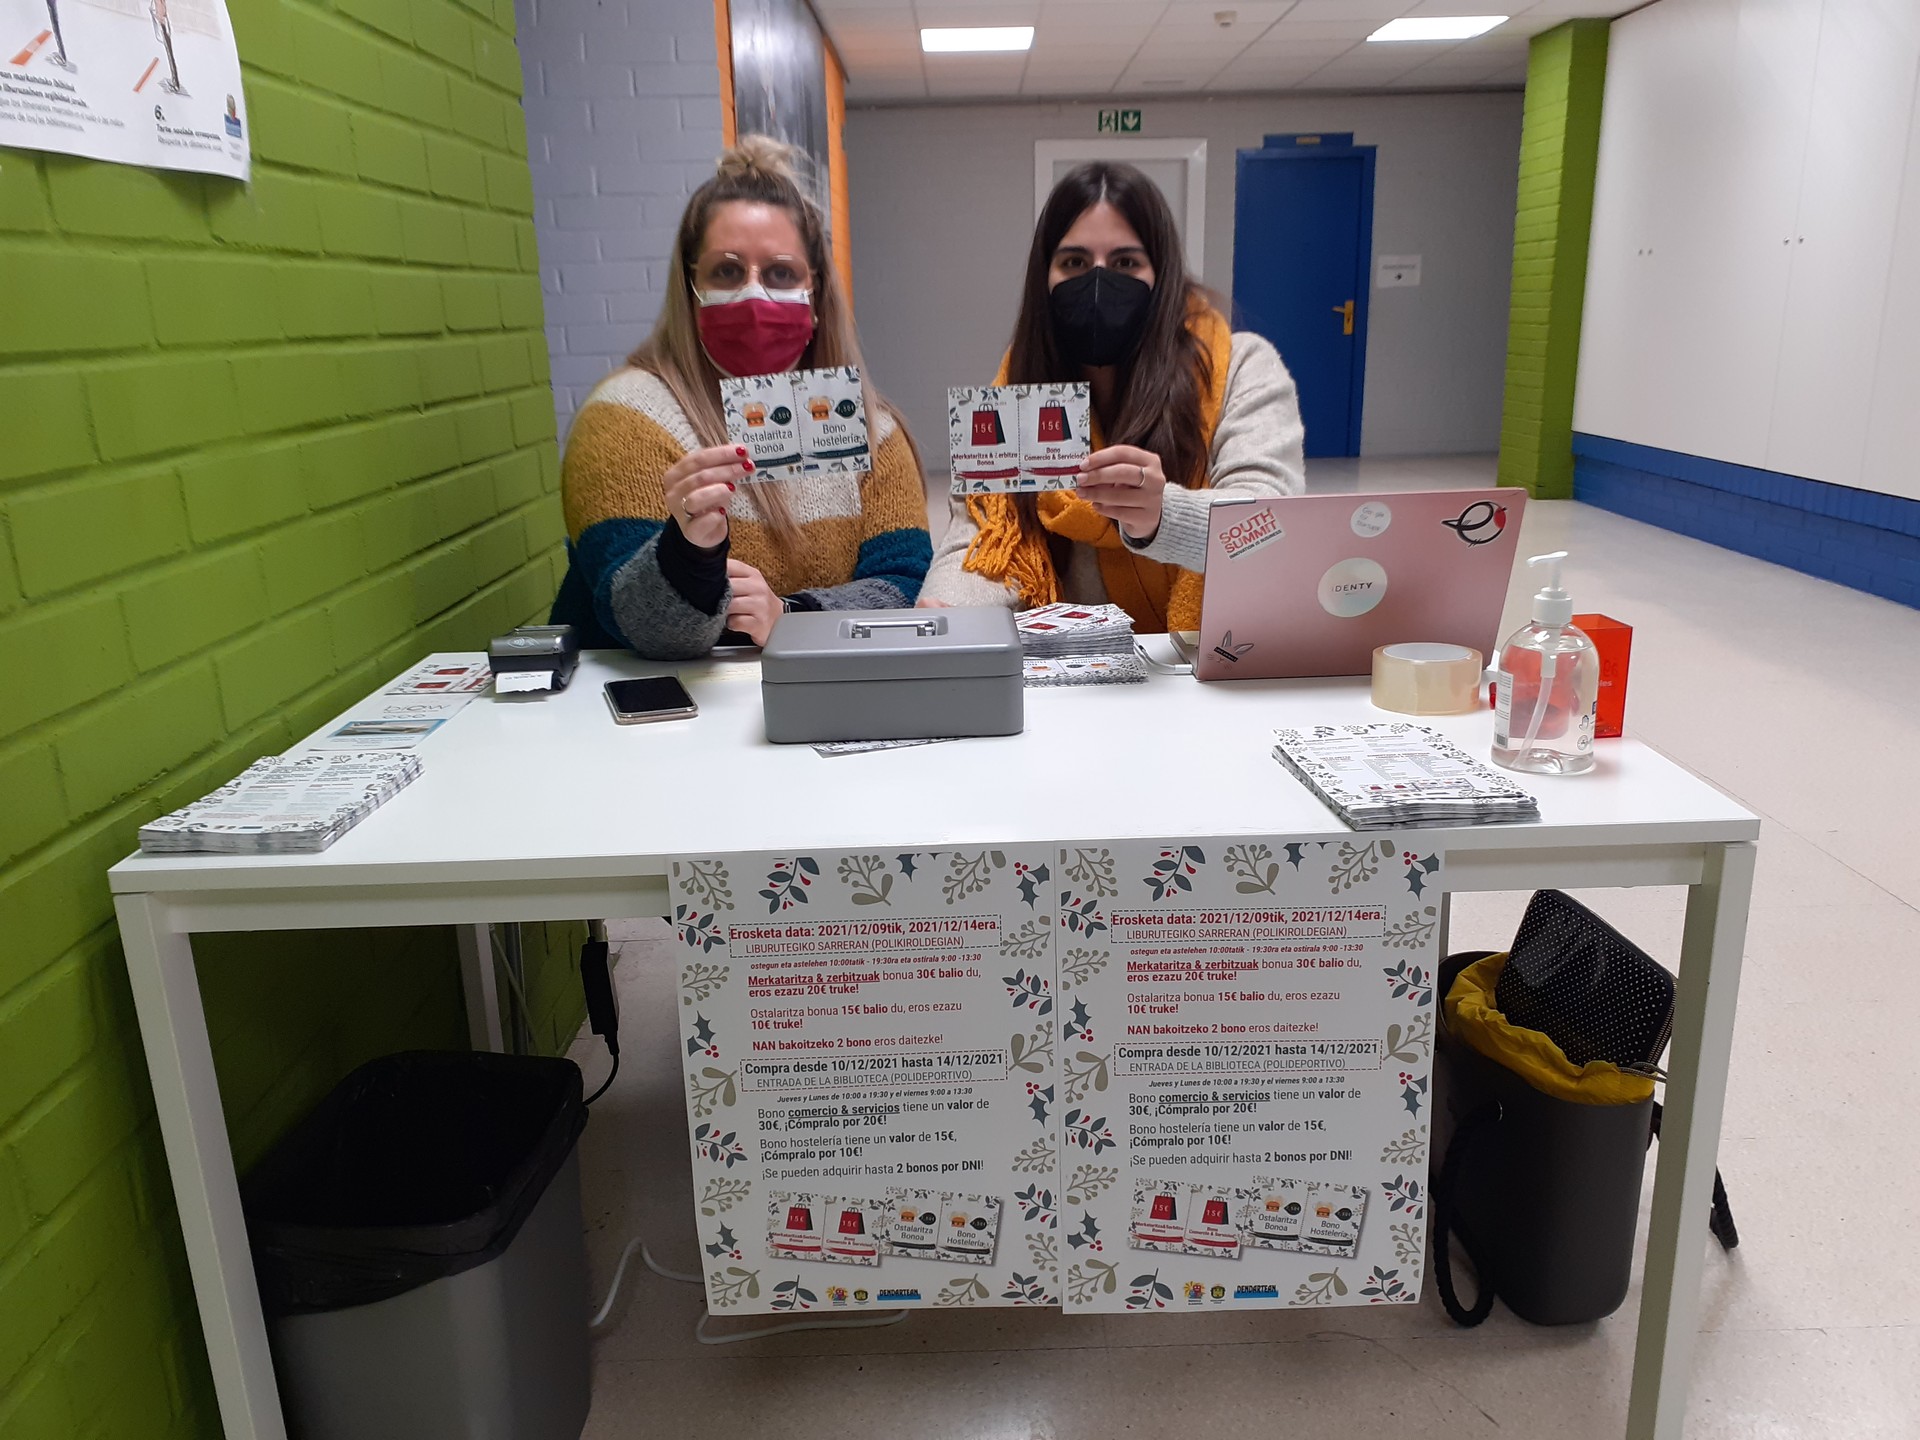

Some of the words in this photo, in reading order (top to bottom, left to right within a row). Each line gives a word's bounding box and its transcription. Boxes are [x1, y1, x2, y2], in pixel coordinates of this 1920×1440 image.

[155, 105, 166, 120] 6.
[823, 424, 846, 434] Bono
[974, 423, 992, 433] 15€
[1042, 420, 1060, 431] 15€
[742, 430, 793, 444] Ostalaritza
[813, 434, 860, 448] Hostelería
[754, 444, 784, 454] Bonoa
[1219, 508, 1274, 544] SOUTH
[1225, 520, 1276, 553] SUMMIT
[1229, 544, 1255, 559] INNOVATION
[1260, 530, 1282, 542] BUSINESS
[1112, 913, 1163, 926] Erosketa
[1166, 912, 1196, 924] data:
[1199, 911, 1287, 925] 2021/12/09tik,
[1291, 909, 1384, 924] 2021/12/14era.
[730, 926, 782, 941] Erosketa
[784, 925, 814, 937] data:
[817, 921, 905, 938] 2021/12/09tik,
[908, 918, 1000, 935] 2021/12/14era.
[1126, 928, 1195, 941] LIBURUTEGIKO
[1197, 928, 1249, 940] SARRERAN
[1252, 925, 1346, 938] (POLIKIROLDEGIAN)
[745, 941, 815, 954] LIBURUTEGIKO
[817, 939, 868, 953] SARRERAN
[871, 935, 964, 949] (POLIKIROLDEGIAN)
[1127, 960, 1191, 972] Merkataritza
[1194, 959, 1201, 972] &
[1204, 958, 1258, 972] zerbitzuak
[1261, 958, 1293, 968] bonua
[1296, 958, 1315, 968] 30€
[1318, 957, 1344, 967] balio
[1346, 956, 1361, 968] du,
[747, 974, 813, 985] Merkataritza
[816, 973, 823, 984] &
[826, 970, 879, 984] zerbitzuak
[882, 969, 913, 980] bonua
[916, 968, 935, 979] 30€
[938, 967, 963, 978] balio
[965, 966, 980, 978] du,
[1127, 973, 1149, 982] eros
[1151, 972, 1181, 981] ezazu
[1184, 971, 1204, 980] 20€
[1206, 970, 1236, 980] truke!
[748, 986, 771, 997] eros
[774, 985, 804, 996] ezazu
[806, 985, 826, 994] 20€
[828, 983, 859, 994] truke!
[750, 1007, 804, 1018] Ostalaritza
[806, 1004, 838, 1016] bonua
[841, 1004, 860, 1015] 15€
[862, 1002, 888, 1014] balio
[890, 1002, 905, 1014] du,
[908, 1003, 930, 1012] eros
[932, 1002, 961, 1011] ezazu
[751, 1019, 770, 1030] 10€
[772, 1018, 802, 1029] truke!
[752, 1040, 775, 1050] NAN
[778, 1037, 834, 1050] bakoitzeko
[836, 1037, 843, 1047] 2
[846, 1036, 871, 1047] bono
[874, 1037, 896, 1046] eros
[898, 1033, 942, 1045] daitezke!
[1118, 1046, 1163, 1060] Compra
[1166, 1044, 1200, 1056] desde
[1204, 1044, 1270, 1056] 10/12/2021
[1274, 1043, 1306, 1054] hasta
[1310, 1042, 1376, 1055] 14/12/2021
[744, 1061, 790, 1076] Compra
[792, 1060, 828, 1072] desde
[831, 1057, 896, 1071] 10/12/2021
[901, 1055, 933, 1067] hasta
[936, 1052, 1002, 1067] 14/12/2021
[1129, 1061, 1174, 1072] ENTRADA
[1176, 1061, 1188, 1072] DE
[1190, 1061, 1203, 1072] LA
[1205, 1060, 1261, 1072] BIBLIOTECA
[1262, 1058, 1345, 1070] (POLIDEPORTIVO)
[757, 1077, 801, 1088] ENTRADA
[803, 1076, 816, 1088] DE
[818, 1076, 831, 1087] LA
[833, 1073, 888, 1085] BIBLIOTECA
[890, 1070, 972, 1082] (POLIDEPORTIVO)
[757, 1107, 785, 1119] Bono
[787, 1104, 838, 1119] comercio
[840, 1104, 848, 1116] &
[851, 1102, 900, 1116] servicios
[902, 1101, 928, 1112] tiene
[931, 1102, 944, 1110] un
[946, 1099, 973, 1110] valor
[976, 1098, 989, 1109] de
[1128, 1104, 1151, 1116] 30€,
[1154, 1103, 1209, 1117] ¡Cómpralo
[1212, 1102, 1230, 1115] por
[1232, 1101, 1256, 1113] 20€!
[758, 1119, 781, 1132] 30€,
[784, 1117, 839, 1130] ¡Cómpralo
[842, 1114, 860, 1129] por
[862, 1114, 886, 1125] 20€!
[759, 1137, 787, 1149] Bono
[789, 1135, 841, 1147] hostelería
[844, 1134, 870, 1144] tiene
[873, 1135, 886, 1144] un
[888, 1131, 915, 1143] valor
[918, 1131, 931, 1142] de
[934, 1130, 956, 1142] 15€,
[760, 1149, 815, 1162] ¡Cómpralo
[818, 1149, 836, 1160] por
[839, 1146, 862, 1157] 10€!
[761, 1167, 778, 1180] ¡Se
[780, 1166, 819, 1180] pueden
[822, 1164, 862, 1178] adquirir
[864, 1162, 893, 1174] hasta
[896, 1162, 903, 1173] 2
[906, 1161, 938, 1173] bonos
[941, 1162, 959, 1174] por
[961, 1159, 983, 1170] DNI!
[1259, 1214, 1297, 1224] Ostalaritza
[1265, 1223, 1288, 1231] Bonoa
[1321, 1220, 1340, 1229] Bono
[894, 1224, 933, 1234] Ostalaritza
[901, 1232, 924, 1240] Bonoa
[957, 1230, 976, 1238] Bono
[1310, 1228, 1347, 1237] Hostelería
[947, 1237, 984, 1247] Hostelería
